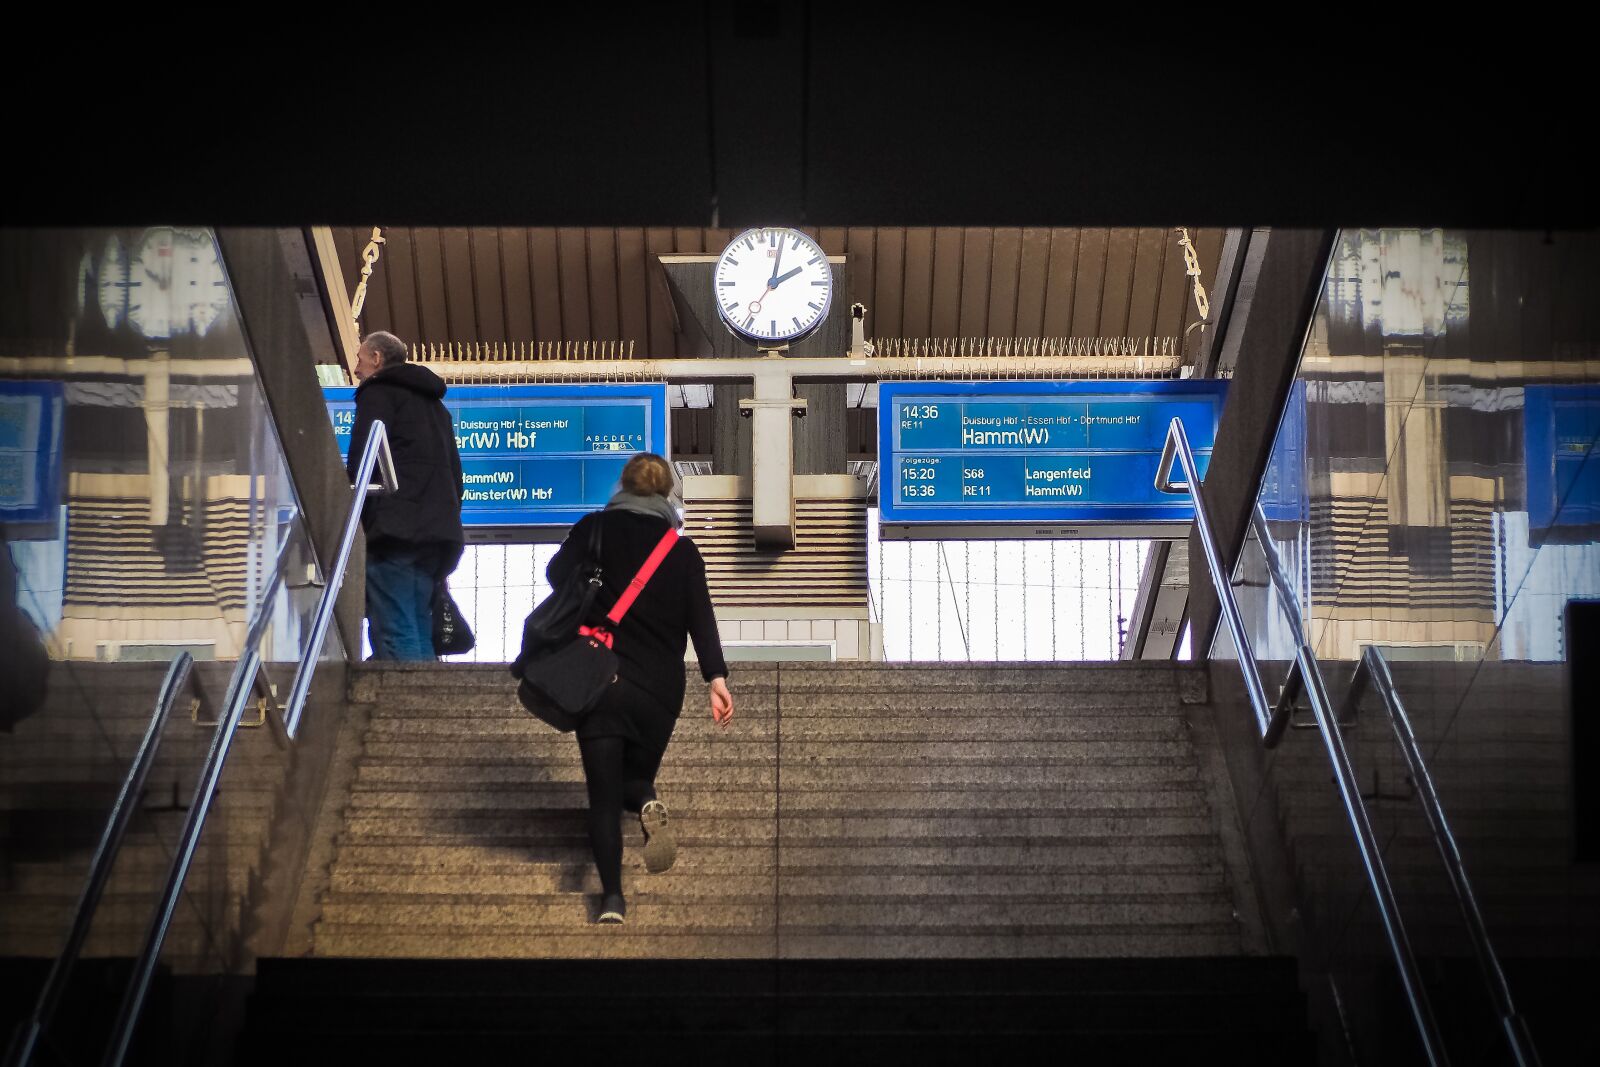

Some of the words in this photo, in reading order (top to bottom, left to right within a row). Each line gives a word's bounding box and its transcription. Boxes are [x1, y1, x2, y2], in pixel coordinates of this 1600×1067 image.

[336, 411, 356, 424] 14:
[902, 405, 939, 419] 14:36
[460, 420, 499, 431] Duisburg
[500, 420, 516, 429] Hbf
[525, 420, 552, 429] Essen
[554, 419, 569, 428] Hbf
[963, 416, 1002, 427] Duisburg
[1003, 416, 1018, 425] Hbf
[1027, 416, 1054, 425] Essen
[1056, 416, 1071, 425] Hbf
[1080, 416, 1123, 425] Dortmund
[1125, 415, 1141, 424] Hbf
[455, 432, 500, 449] er(W)
[506, 431, 537, 449] Hbf
[963, 428, 1049, 445] Hamm(W)
[902, 468, 936, 480] 15:20
[964, 468, 985, 479] S68
[1026, 467, 1091, 482] Langenfeld
[531, 487, 553, 500] Hbf
[902, 485, 936, 497] 15:36
[1026, 484, 1083, 497] Hamm(W)
